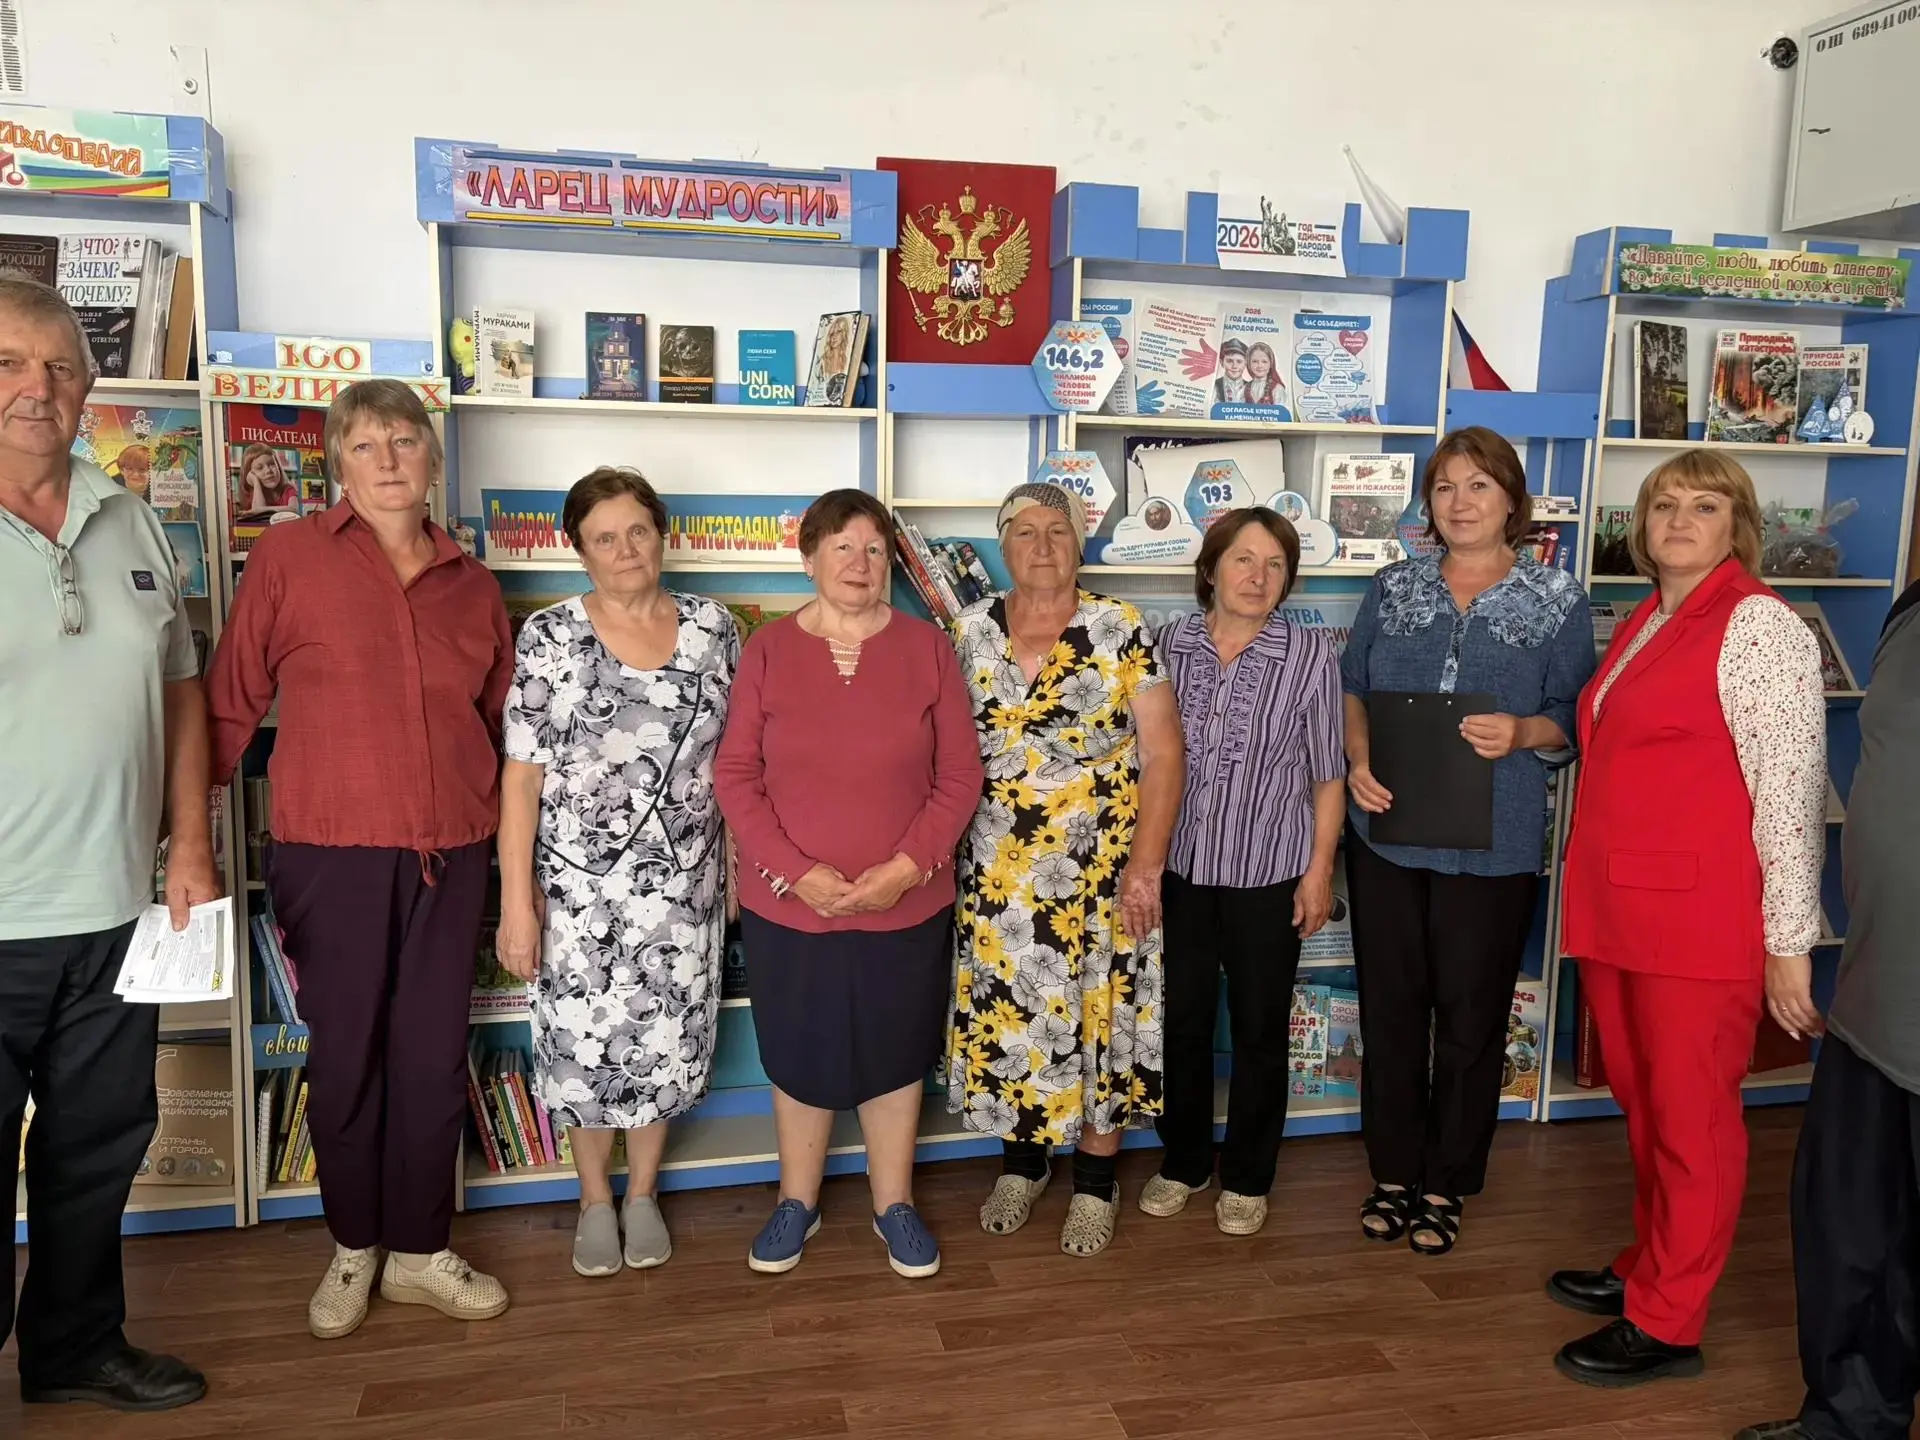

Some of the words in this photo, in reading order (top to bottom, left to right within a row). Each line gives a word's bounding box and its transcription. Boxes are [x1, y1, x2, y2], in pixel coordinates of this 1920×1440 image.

[0, 120, 141, 175] ИКЛОПЕДИЙ
[466, 165, 612, 214] «ЛАРЕЦ
[623, 175, 839, 226] МУДРОСТИ»
[1297, 222, 1313, 233] ГОД
[1217, 223, 1260, 249] 2026
[1297, 232, 1336, 243] ЕДИНСТВА
[84, 237, 119, 256] ЧТО?
[1297, 241, 1332, 251] НАРОДОВ
[1298, 250, 1329, 259] РОССИИ
[1626, 243, 1711, 269] «Давайте,
[1716, 252, 1762, 271] люди,
[1767, 253, 1828, 273] любить
[1832, 261, 1895, 278] планету
[66, 261, 120, 279] ЗАЧЕМ?
[1628, 270, 1647, 283] во
[1653, 267, 1692, 285] всей
[1698, 272, 1780, 290] вселенной
[1786, 278, 1851, 295] похожей
[64, 285, 132, 303] ПОЧЕМУ?
[1092, 304, 1119, 312] РОССИИ
[1245, 307, 1262, 315] 2026
[483, 316, 530, 330] МУРАКАМИ
[1229, 315, 1241, 323] ГОД
[1242, 316, 1275, 325] ЕДИНСТВА
[1303, 318, 1317, 327] НАС
[1224, 323, 1254, 332] НАРОДОВ
[91, 336, 121, 344] ОТВЕТОВ
[1739, 333, 1795, 344] Природные
[1738, 344, 1797, 355] катастрофы
[280, 342, 362, 370] 100
[1046, 346, 1104, 372] 146,2
[1803, 352, 1846, 360] ПРИРОДА
[739, 370, 769, 385] UNI
[1054, 373, 1097, 382] МИЛЛИОНА
[748, 384, 795, 399] CORN
[242, 427, 317, 446] ПИСАТЕЛИ
[1331, 483, 1355, 491] МИНИН
[1363, 483, 1406, 491] ПОЖАРСКИЙ
[1201, 484, 1233, 503] 193
[490, 499, 557, 558] Подарок
[1282, 607, 1325, 624] СТВА
[1289, 1051, 1323, 1060] АРОДОВ
[168, 1089, 235, 1099] овременная
[161, 1107, 229, 1118] нциклопедия
[170, 1146, 215, 1155] ГОРОДА
